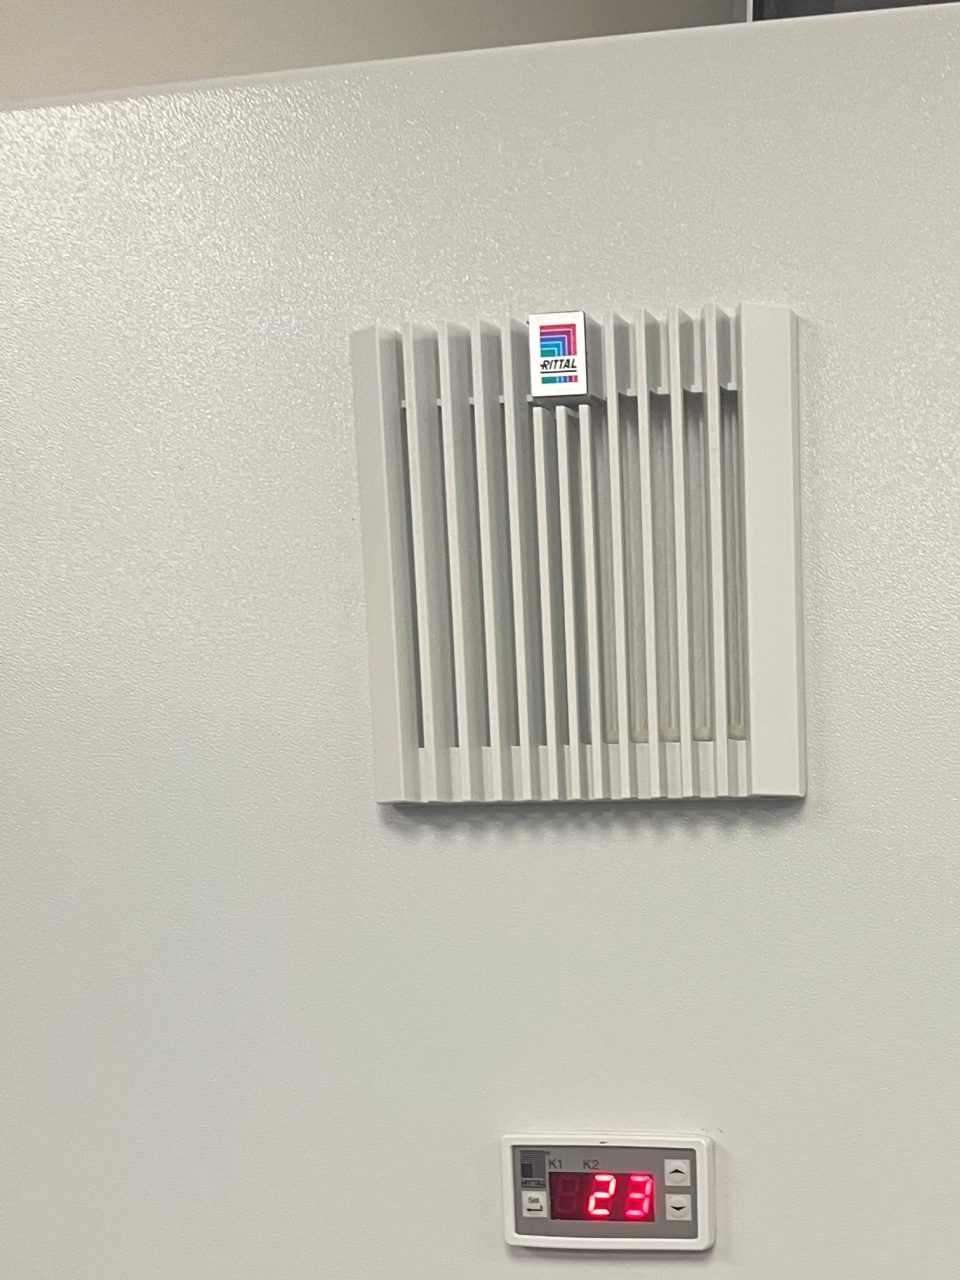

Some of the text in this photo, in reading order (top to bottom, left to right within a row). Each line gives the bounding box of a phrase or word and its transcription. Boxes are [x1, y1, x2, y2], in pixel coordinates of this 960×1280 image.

[540, 358, 577, 370] RITTAL
[548, 1158, 562, 1169] K1
[583, 1159, 600, 1170] K2
[588, 1173, 653, 1217] 23
